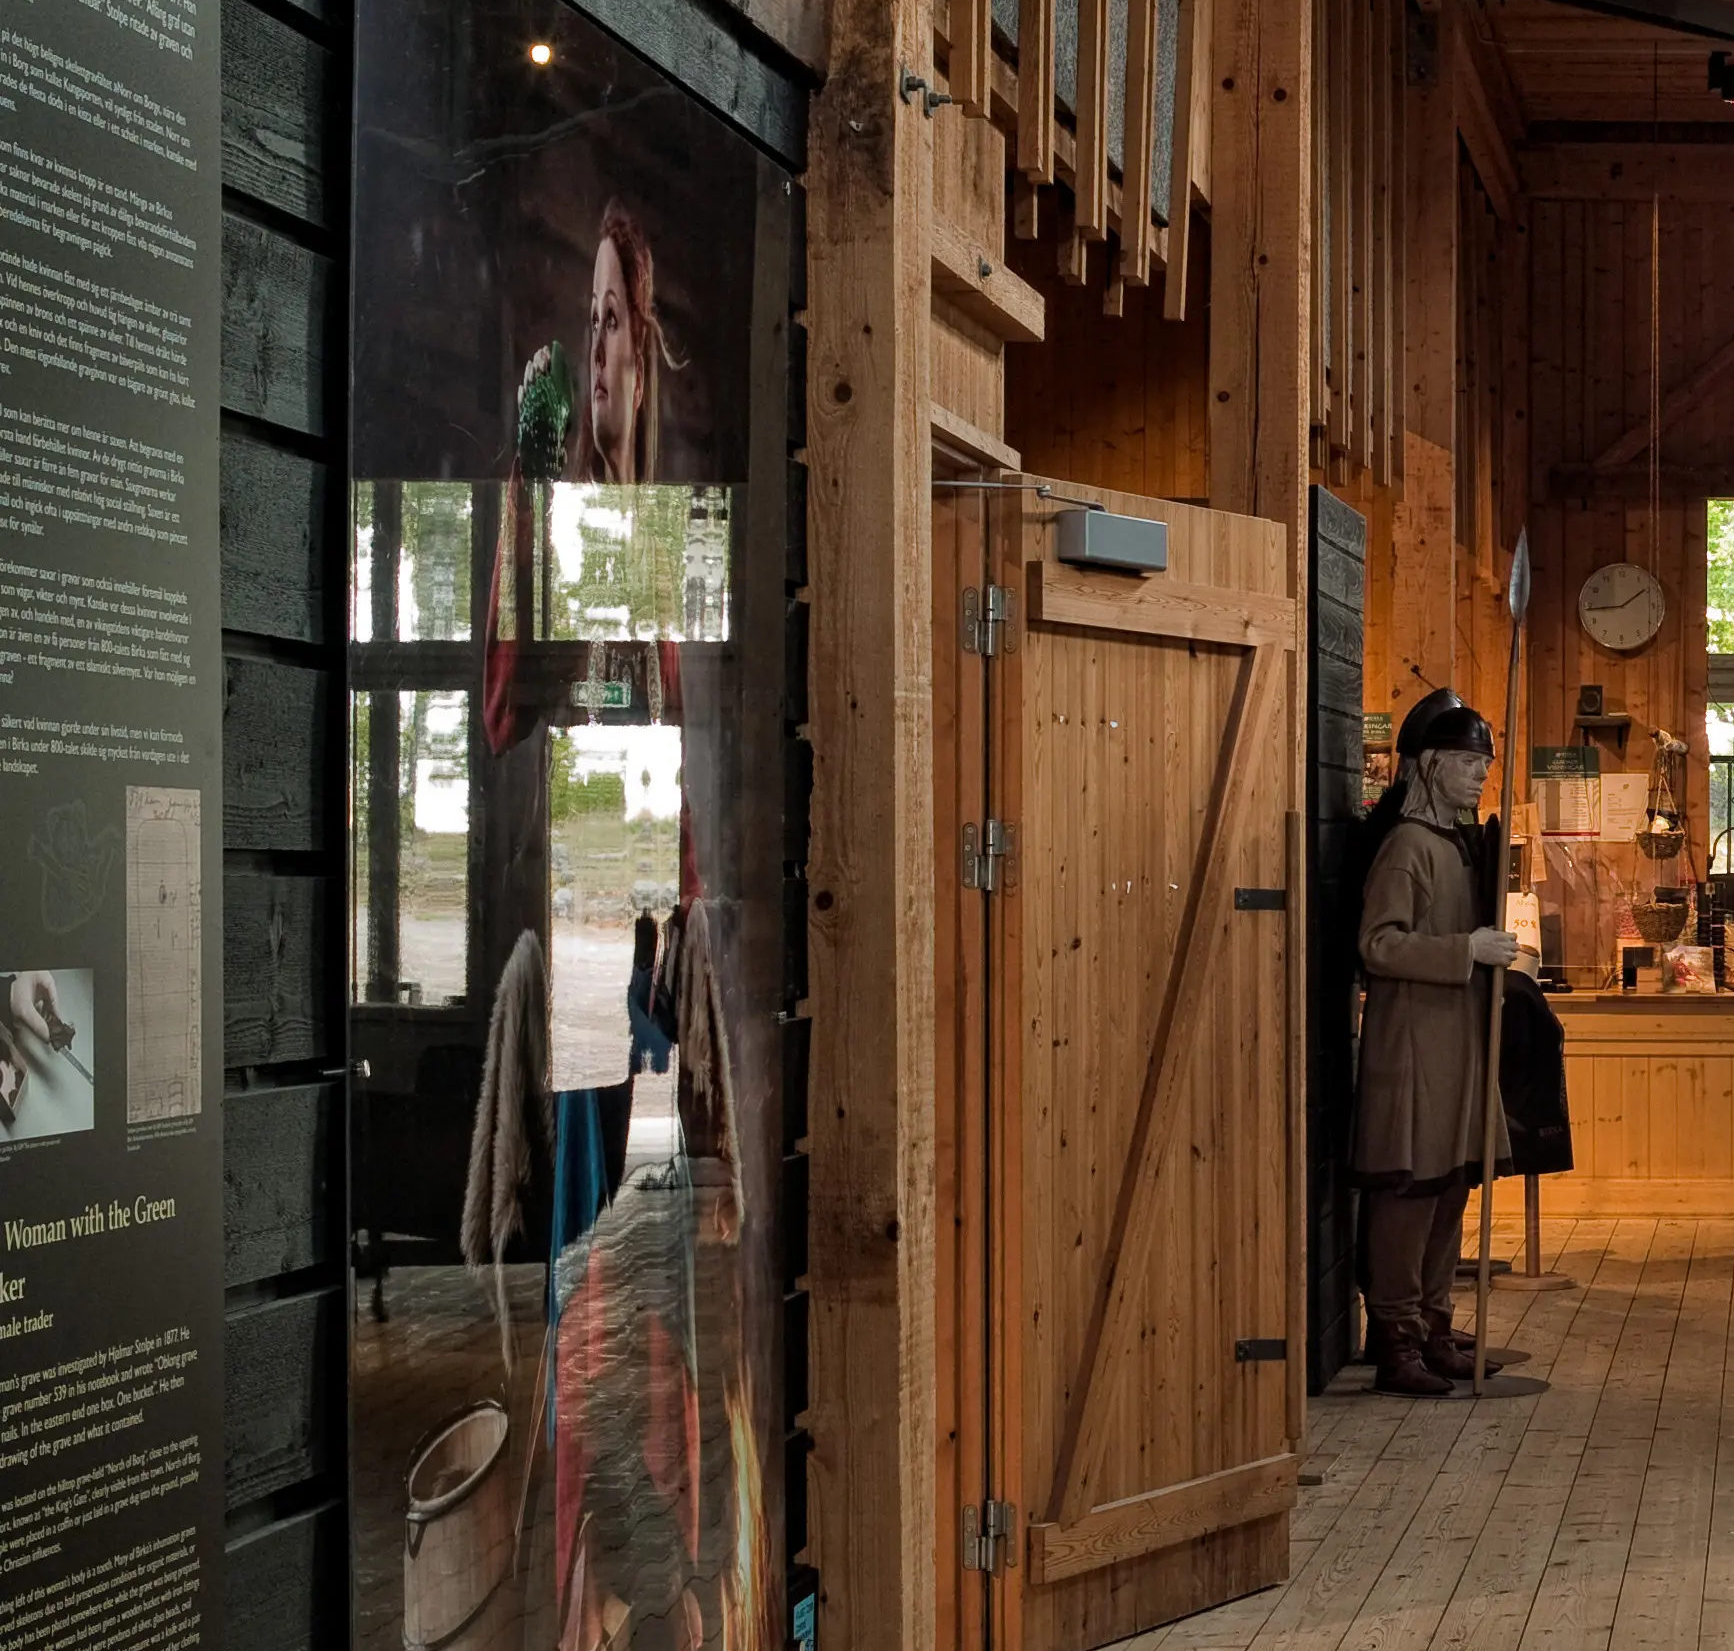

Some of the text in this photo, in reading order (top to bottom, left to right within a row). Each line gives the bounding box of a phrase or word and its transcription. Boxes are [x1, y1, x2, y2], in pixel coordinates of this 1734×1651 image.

[106, 0, 128, 28] Stolpe
[129, 14, 149, 37] ritade
[149, 27, 158, 41] av
[158, 24, 180, 53] graven
[180, 43, 193, 60] och
[18, 276, 41, 296] hennes
[42, 284, 75, 310] överkropp
[76, 298, 88, 311] och
[1513, 918, 1528, 929] 50
[4, 1195, 175, 1250] Woman with the Green
[23, 1309, 53, 1333] trader
[20, 1371, 41, 1391] grave
[41, 1367, 56, 1380] was
[57, 1351, 97, 1376] investigated
[98, 1350, 107, 1368] by
[108, 1344, 134, 1364] Hjalmar
[134, 1337, 154, 1354] Stolpe
[180, 1326, 190, 1341] He
[0, 1424, 19, 1443] nails.
[30, 1418, 43, 1434] the
[43, 1412, 70, 1429] eastern
[71, 1402, 85, 1420] end
[86, 1402, 99, 1416] one
[100, 1396, 115, 1411] box.
[116, 1391, 131, 1406] One
[159, 1378, 169, 1392] He
[169, 1375, 184, 1389] then
[1, 1401, 22, 1422] grave
[23, 1391, 52, 1411] number
[53, 1384, 67, 1402] 539
[76, 1380, 86, 1395] his
[87, 1369, 120, 1391] notebook
[120, 1364, 133, 1382] and
[181, 1349, 197, 1367] grave
[38, 1440, 51, 1455] the
[52, 1436, 71, 1456] grave
[72, 1427, 86, 1445] and
[86, 1423, 104, 1439] what
[111, 1408, 144, 1431] contained.
[3, 1554, 31, 1572] Christian
